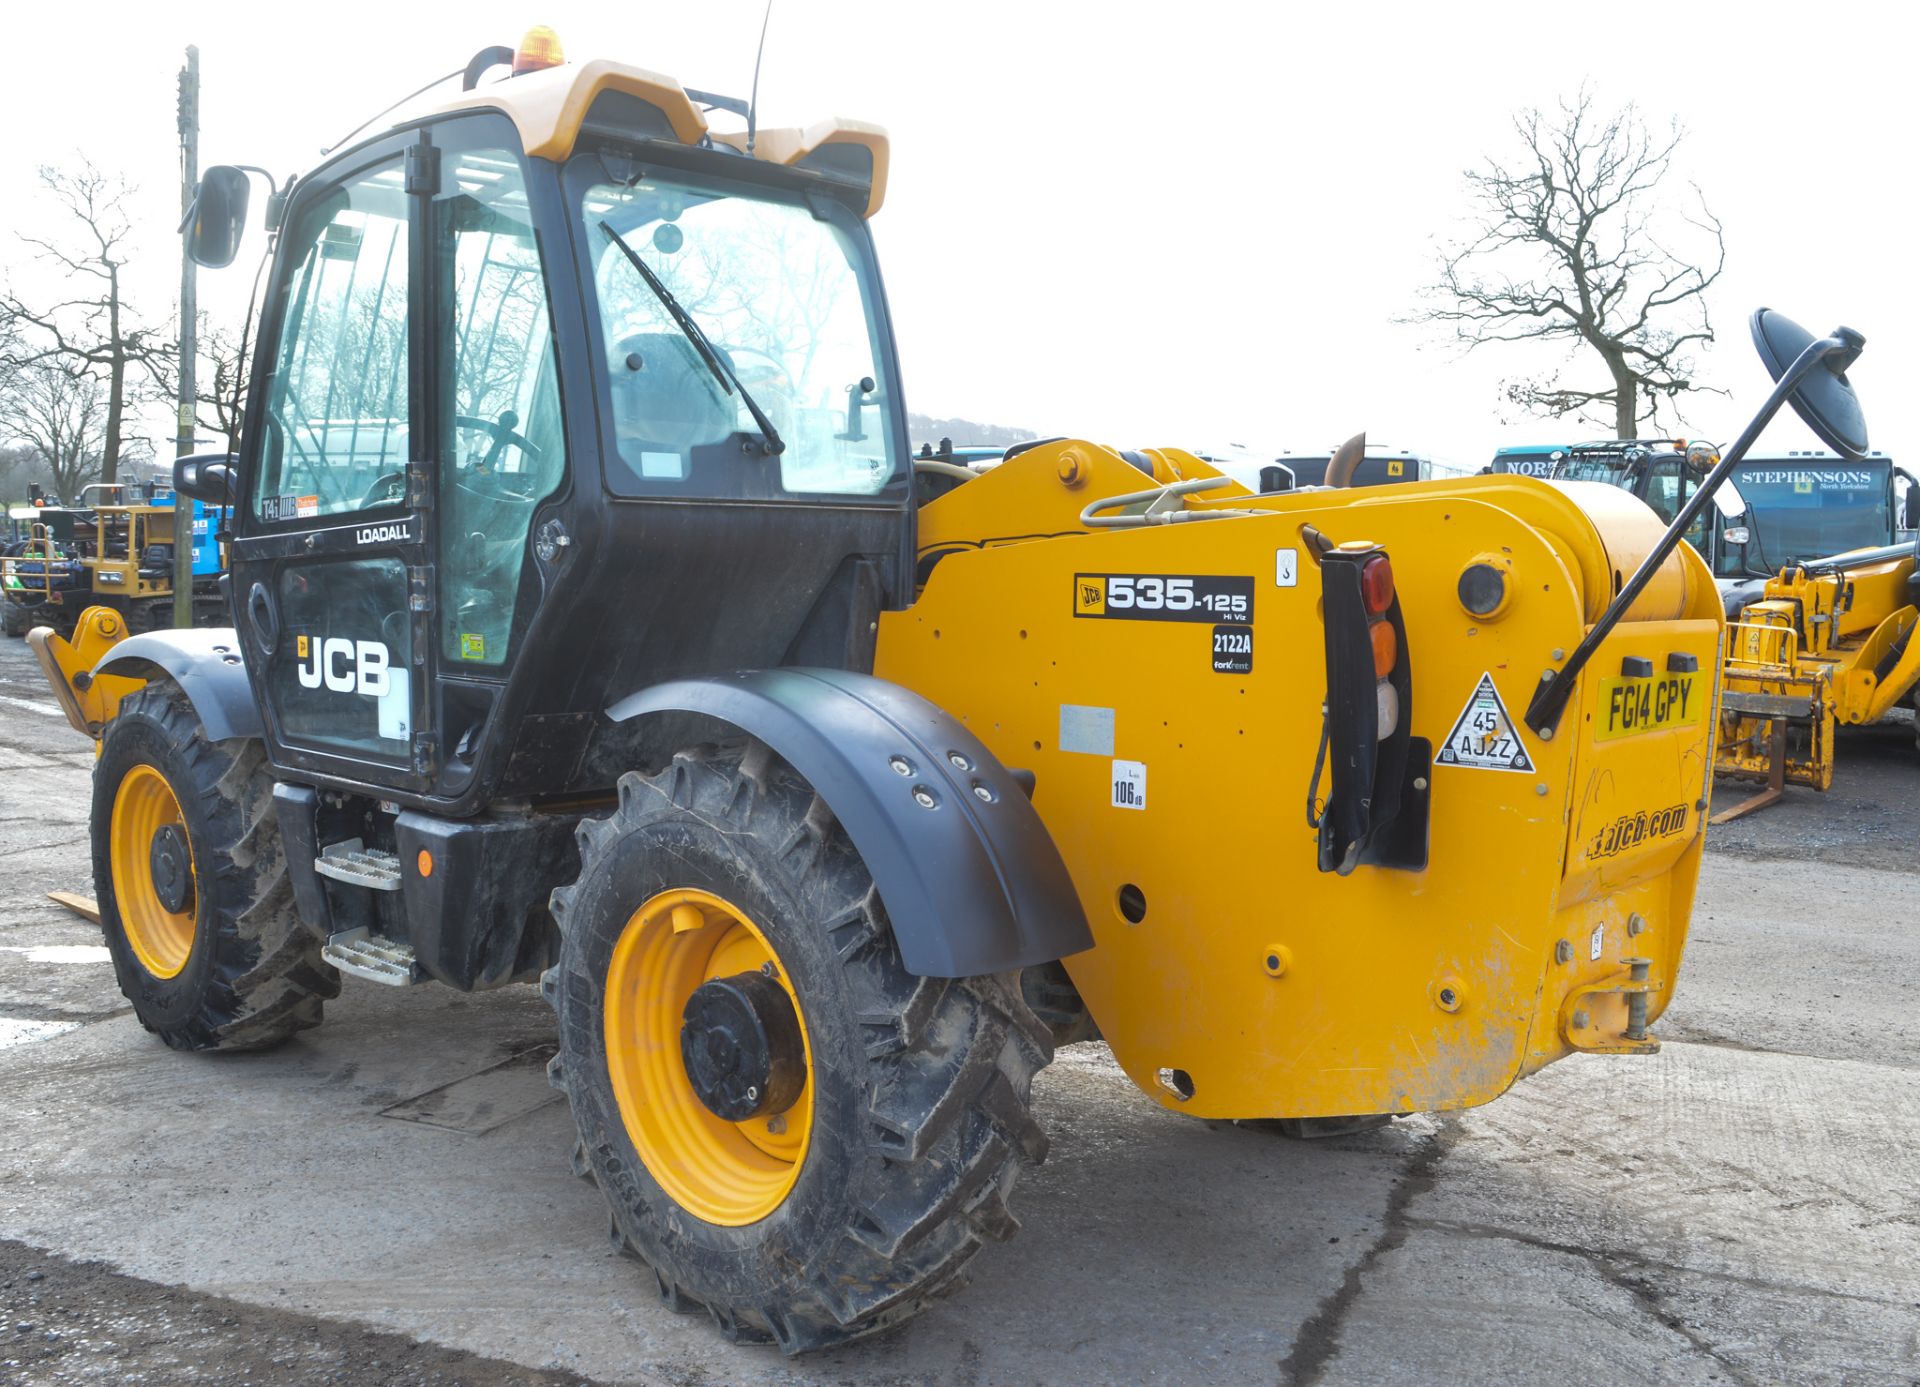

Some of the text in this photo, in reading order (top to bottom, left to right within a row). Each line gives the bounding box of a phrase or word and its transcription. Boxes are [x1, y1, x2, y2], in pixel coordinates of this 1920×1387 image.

[1742, 471, 1871, 484] STEPHENSONS
[356, 524, 410, 544] LOADALL
[1214, 634, 1251, 653] 2122A
[298, 636, 390, 697] JCB
[1609, 678, 1692, 732] FG14 GPY
[1473, 712, 1497, 732] 45
[1460, 735, 1511, 759] AJ2Z
[1115, 780, 1143, 806] 106 dB
